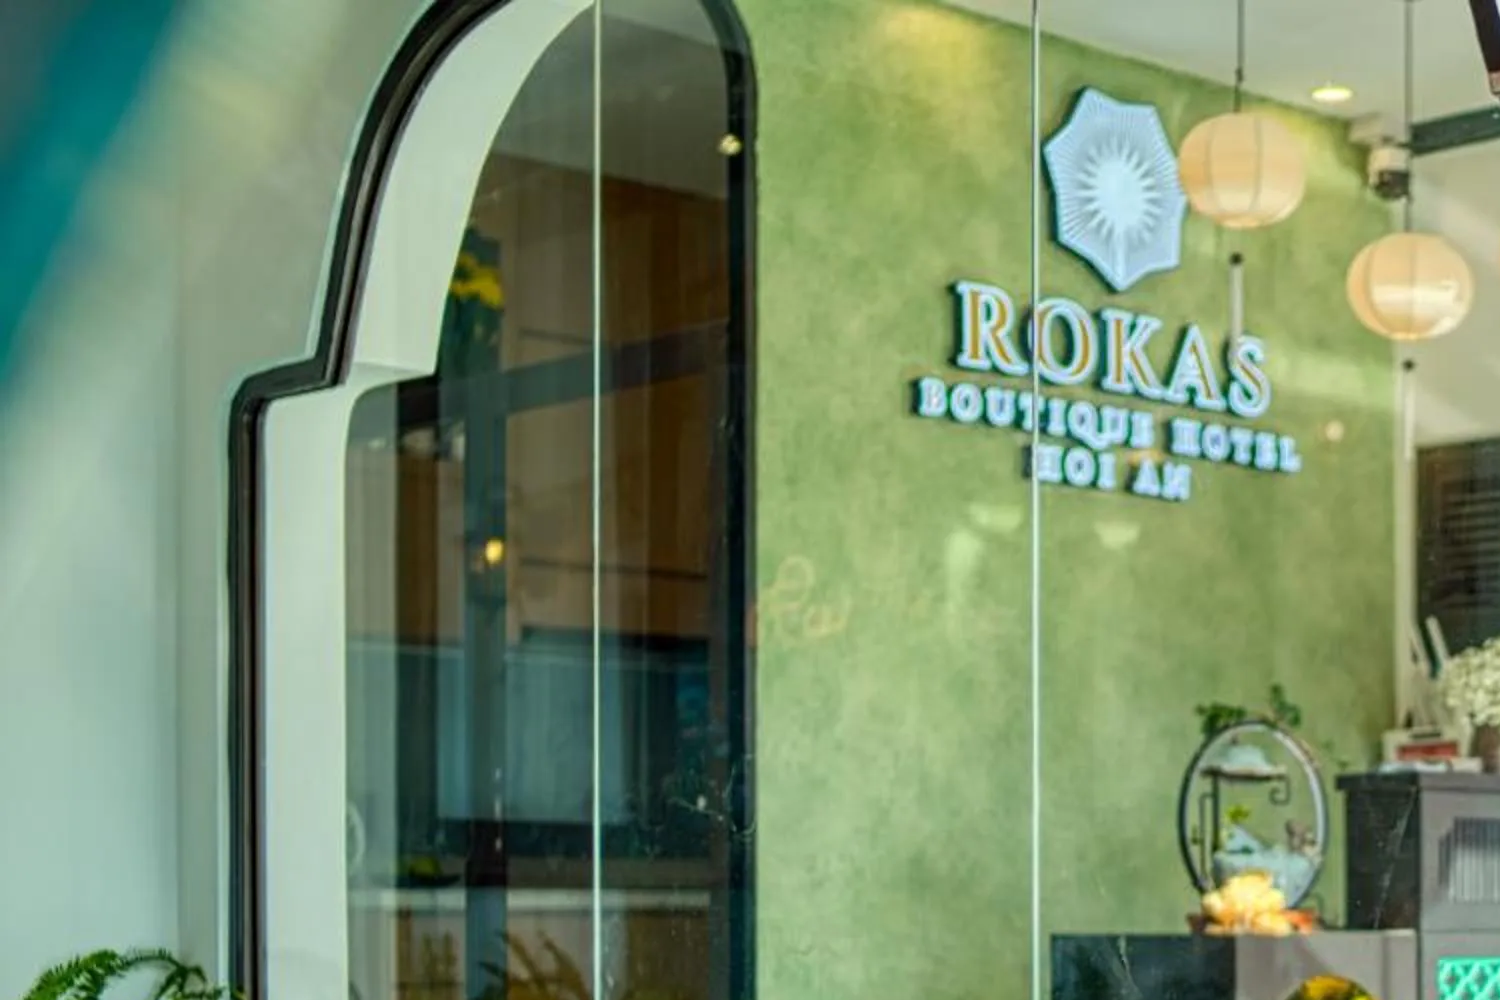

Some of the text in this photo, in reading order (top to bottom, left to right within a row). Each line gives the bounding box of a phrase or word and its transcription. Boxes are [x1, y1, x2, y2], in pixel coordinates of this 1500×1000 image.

[954, 280, 1271, 418] ROKAS
[917, 377, 1301, 473] BOUTIQUE HOTEL
[1031, 444, 1117, 490] HOI
